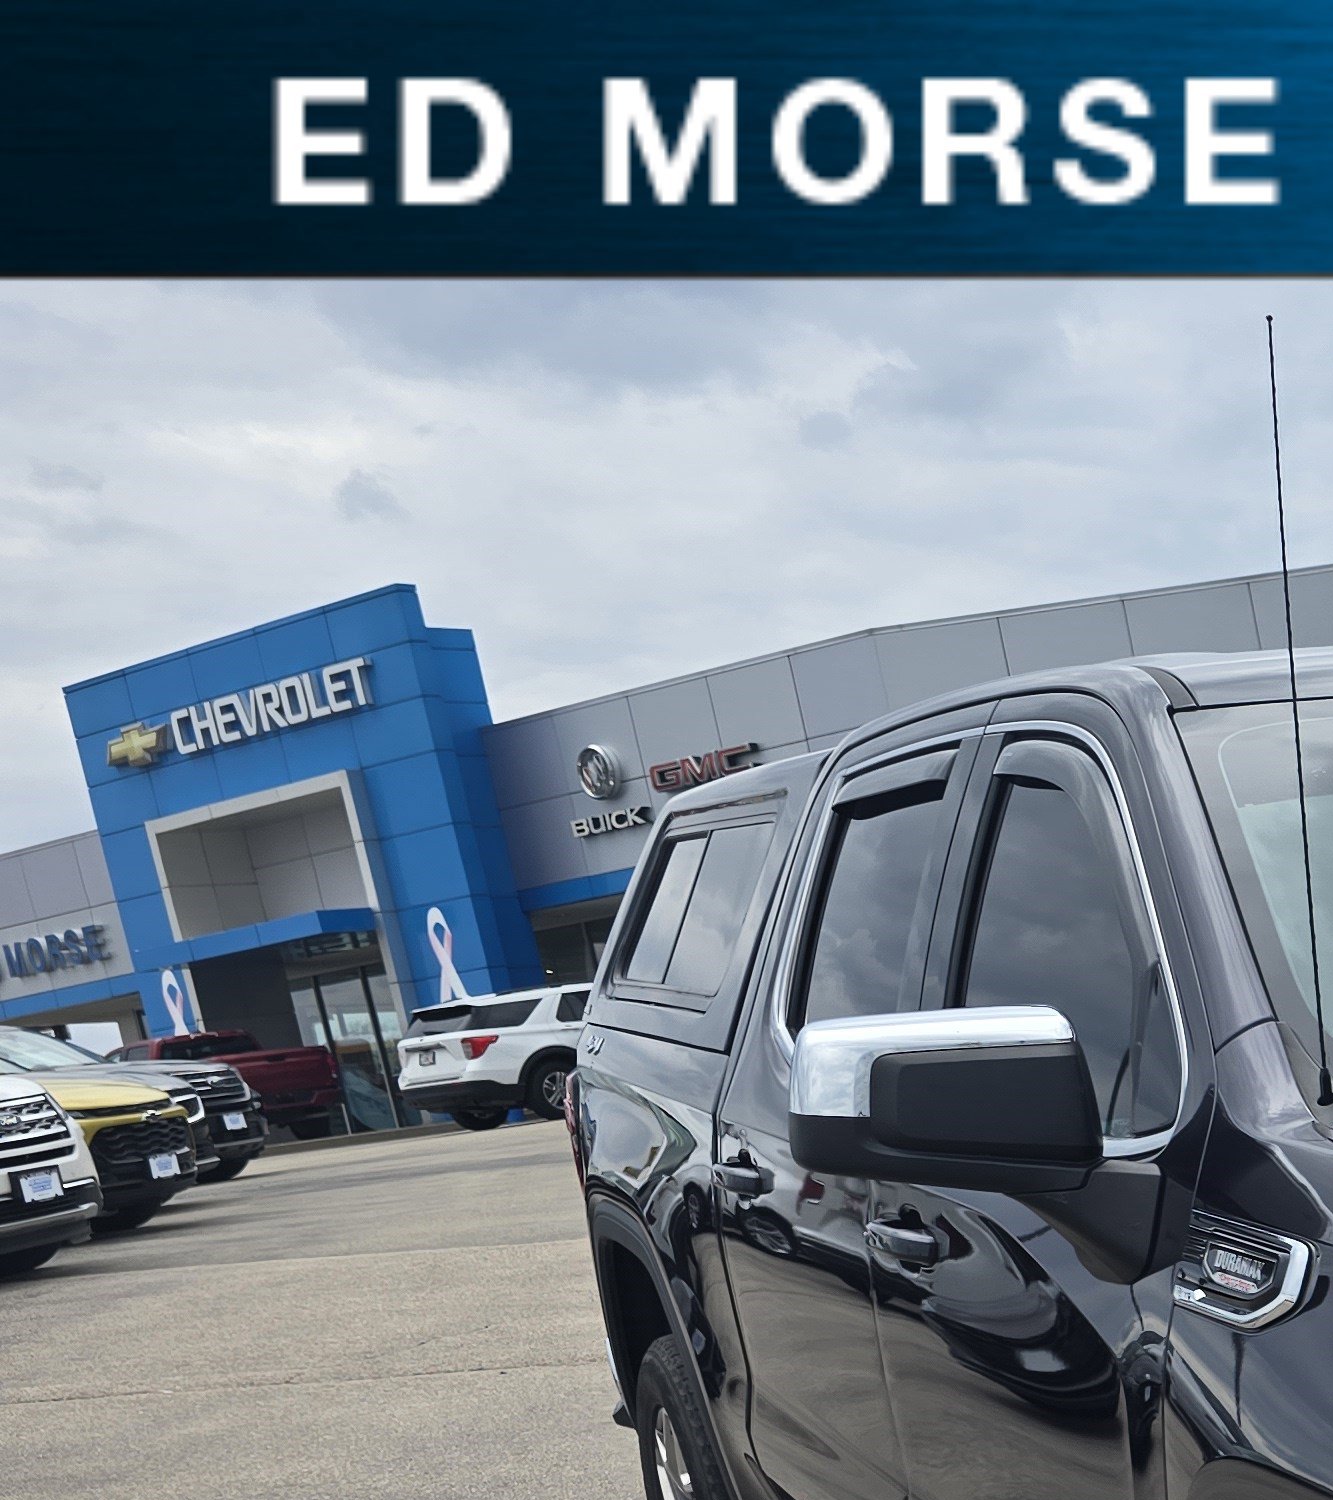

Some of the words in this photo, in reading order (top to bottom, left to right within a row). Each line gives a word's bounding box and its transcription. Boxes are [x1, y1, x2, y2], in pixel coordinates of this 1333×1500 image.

[170, 656, 373, 755] CHEVROLET
[649, 743, 758, 793] GMC
[570, 806, 646, 838] BUICK
[2, 925, 112, 978] MORSE
[1213, 1249, 1266, 1281] DURAMAX
